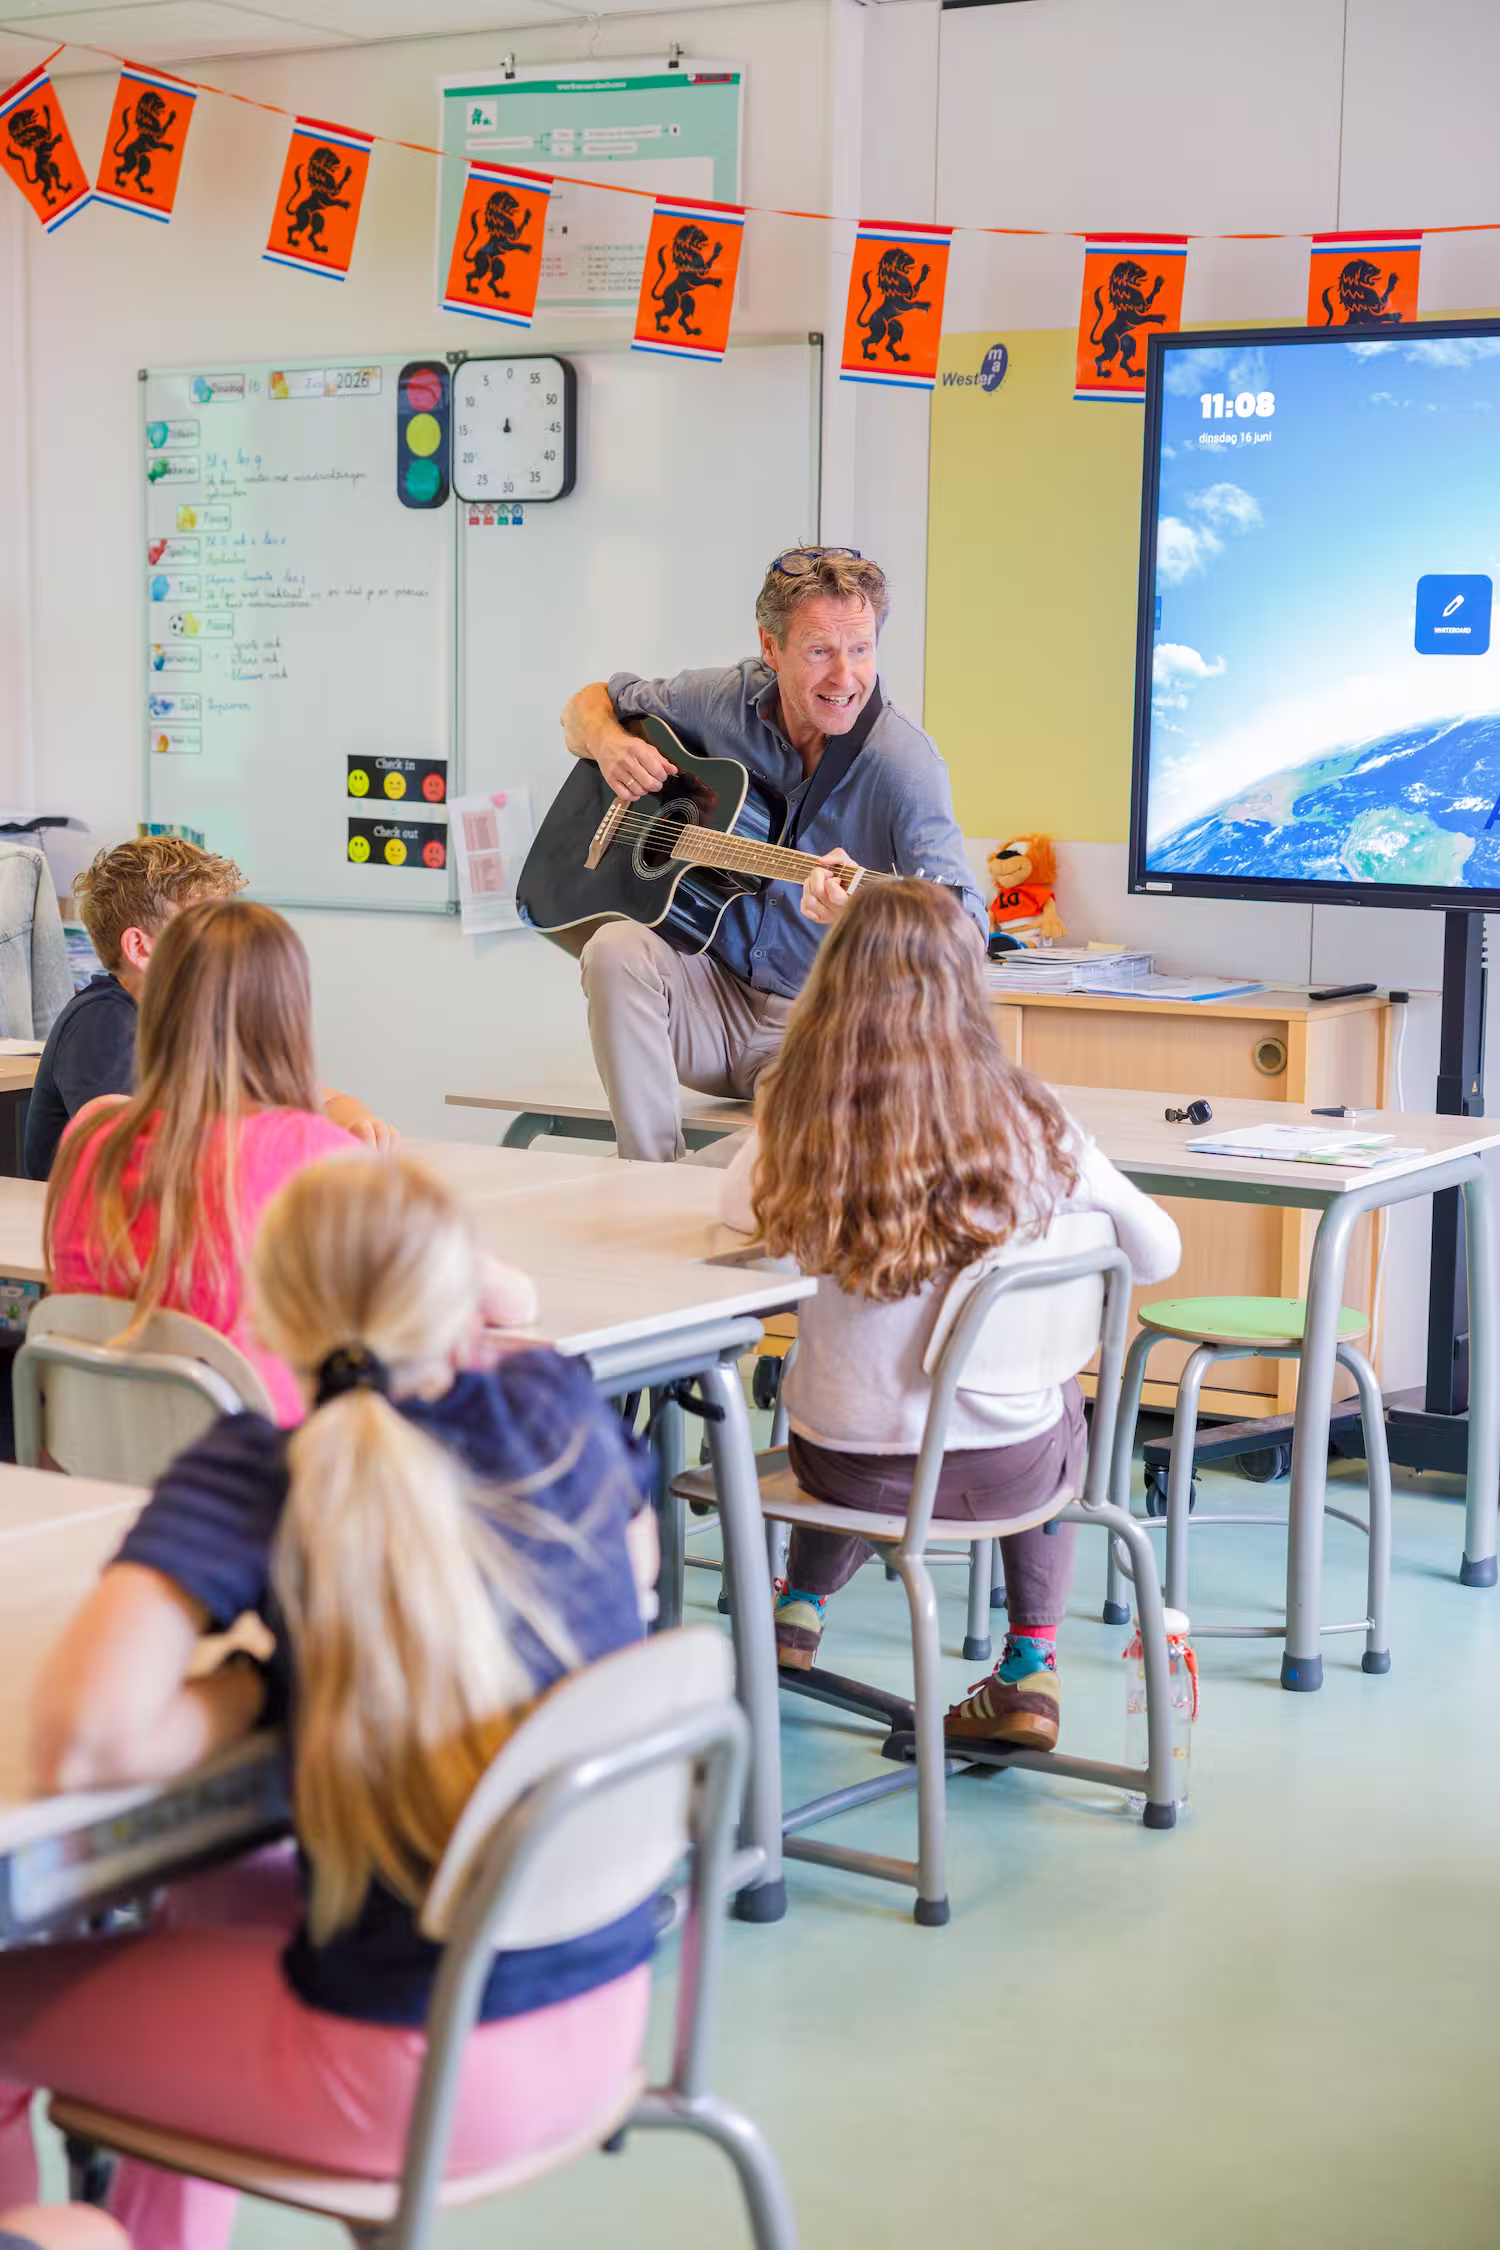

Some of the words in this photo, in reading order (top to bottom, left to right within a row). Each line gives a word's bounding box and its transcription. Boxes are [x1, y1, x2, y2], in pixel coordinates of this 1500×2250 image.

[506, 368, 513, 378] 0
[530, 373, 540, 384] 55
[336, 372, 370, 388] 2026
[484, 375, 488, 386] 5
[943, 372, 995, 386] Wester
[465, 396, 474, 407] 10
[546, 393, 558, 404] 50
[1200, 392, 1275, 418] 11:08
[459, 425, 468, 436] 15
[550, 422, 561, 433] 45
[1199, 432, 1238, 445] dinsdag
[1240, 432, 1252, 442] 16
[1254, 431, 1272, 444] juni
[463, 452, 474, 463] 20
[544, 450, 555, 461] 40
[477, 474, 488, 485] 25
[530, 472, 541, 482] 35
[503, 482, 514, 493] 30
[375, 757, 402, 770] Check
[373, 825, 400, 838] Check
[402, 830, 419, 840] out
